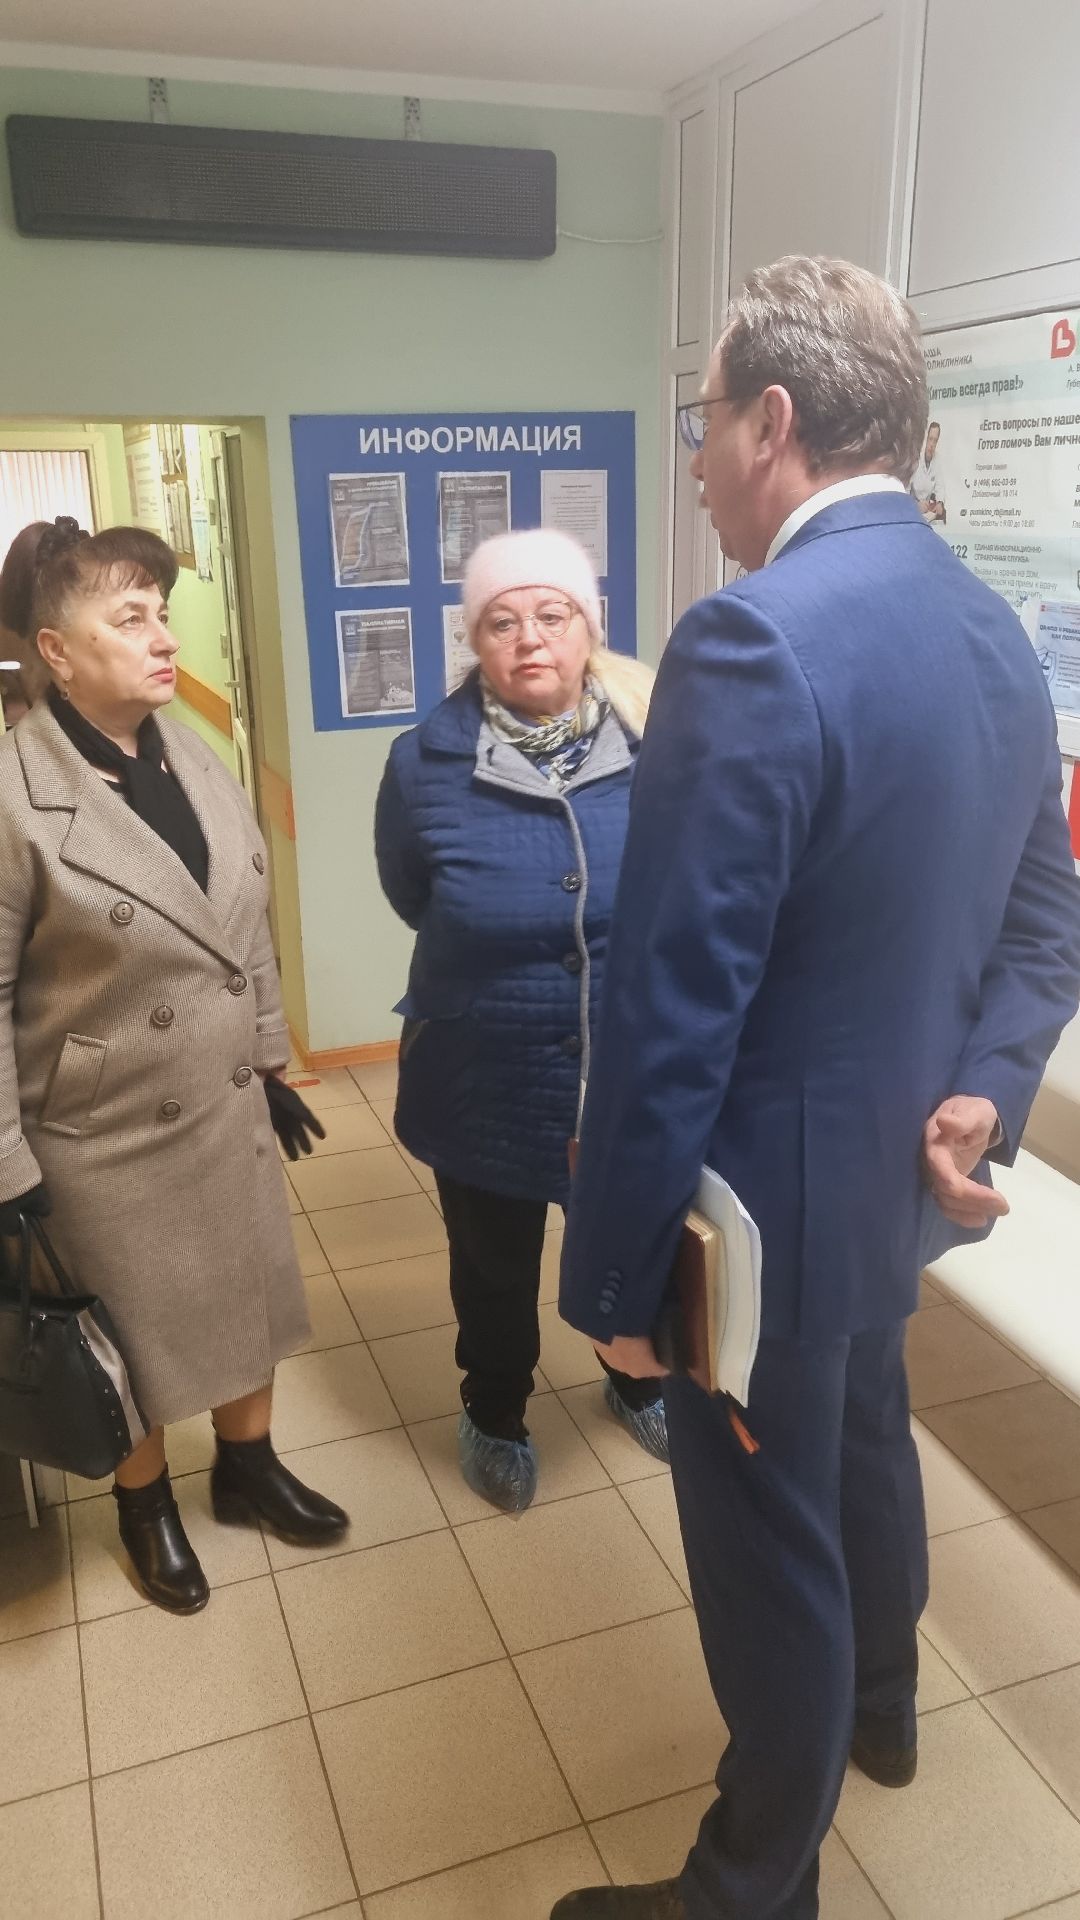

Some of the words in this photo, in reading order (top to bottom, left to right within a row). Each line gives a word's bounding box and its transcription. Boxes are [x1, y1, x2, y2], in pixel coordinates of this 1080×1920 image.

[923, 347, 942, 358] АША
[926, 355, 973, 370] ОЛИКЛИНИКА
[959, 381, 990, 397] всегда
[1003, 417, 1039, 432] вопросы
[1041, 416, 1053, 427] по
[359, 424, 582, 456] ИНФОРМАЦИЯ
[978, 437, 999, 450] Готов
[1000, 436, 1032, 449] помочь
[1034, 434, 1051, 447] Вам
